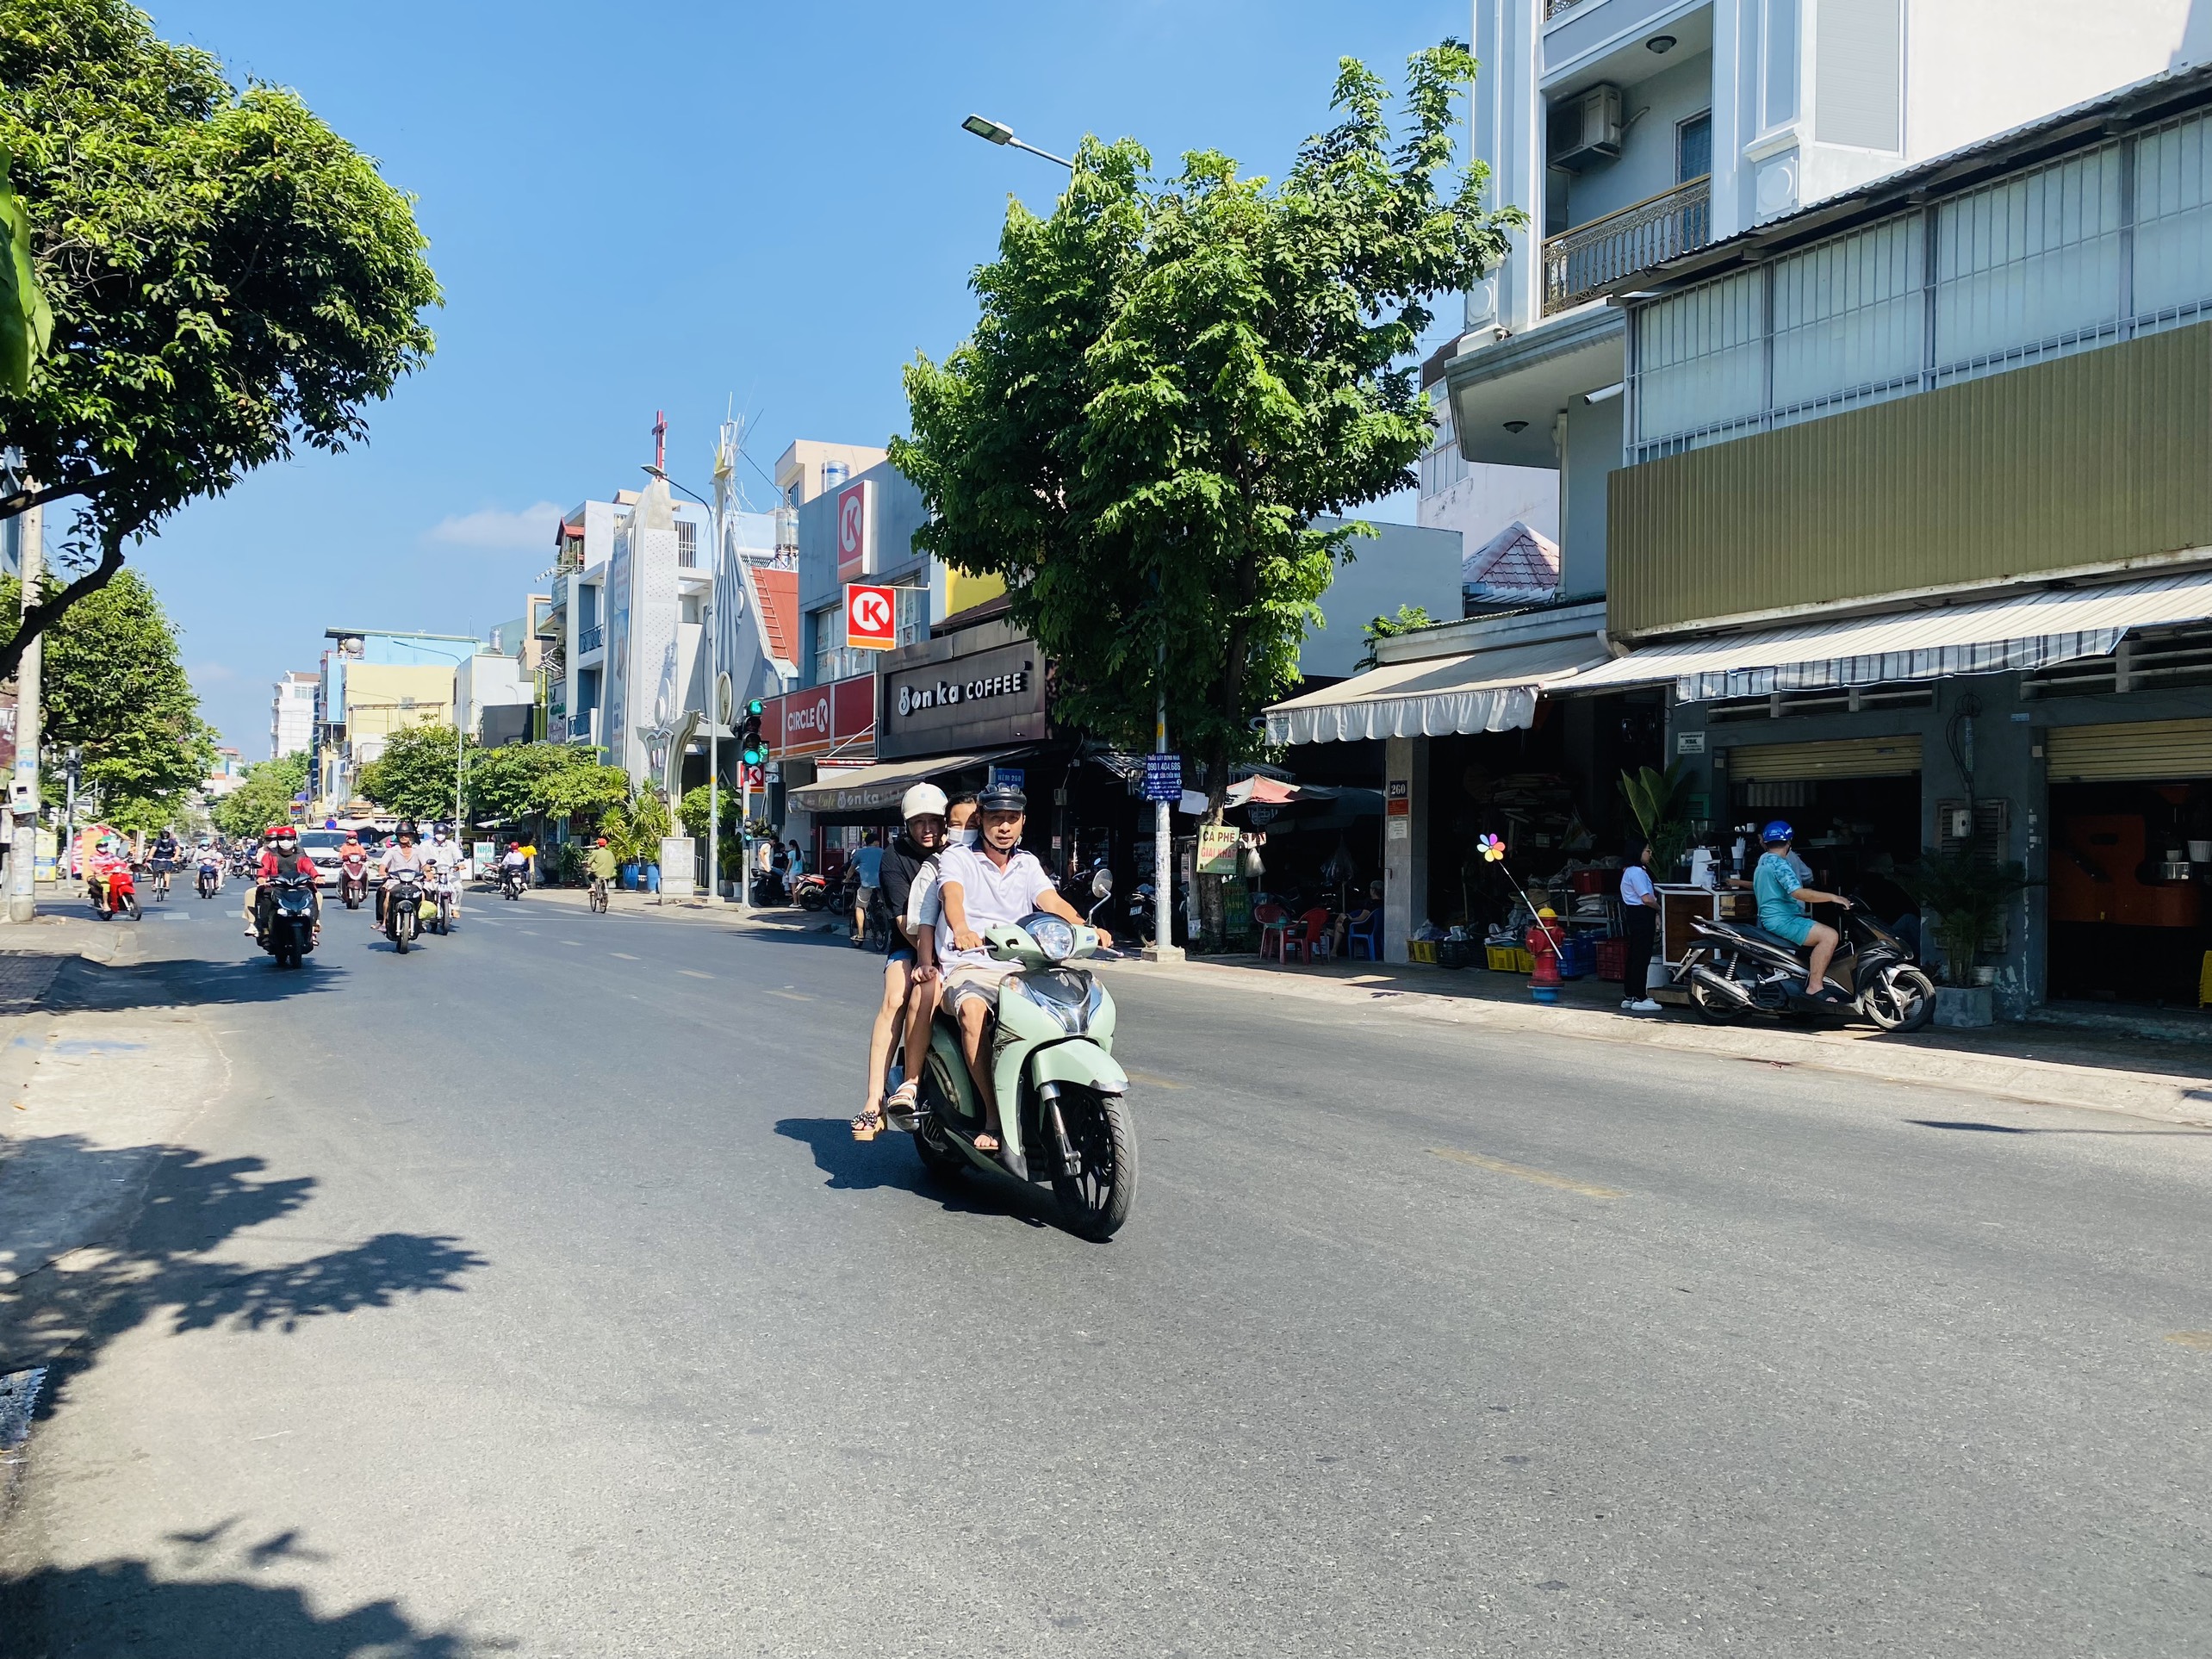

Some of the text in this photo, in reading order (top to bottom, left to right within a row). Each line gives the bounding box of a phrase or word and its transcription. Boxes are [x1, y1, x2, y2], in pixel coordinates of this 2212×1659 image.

[844, 502, 861, 546] K
[859, 597, 887, 631] K
[966, 673, 1022, 699] COFFEE
[787, 703, 828, 732] CIRCLE K
[1391, 784, 1406, 795] 260
[1202, 828, 1235, 842] CÀ PHÊ
